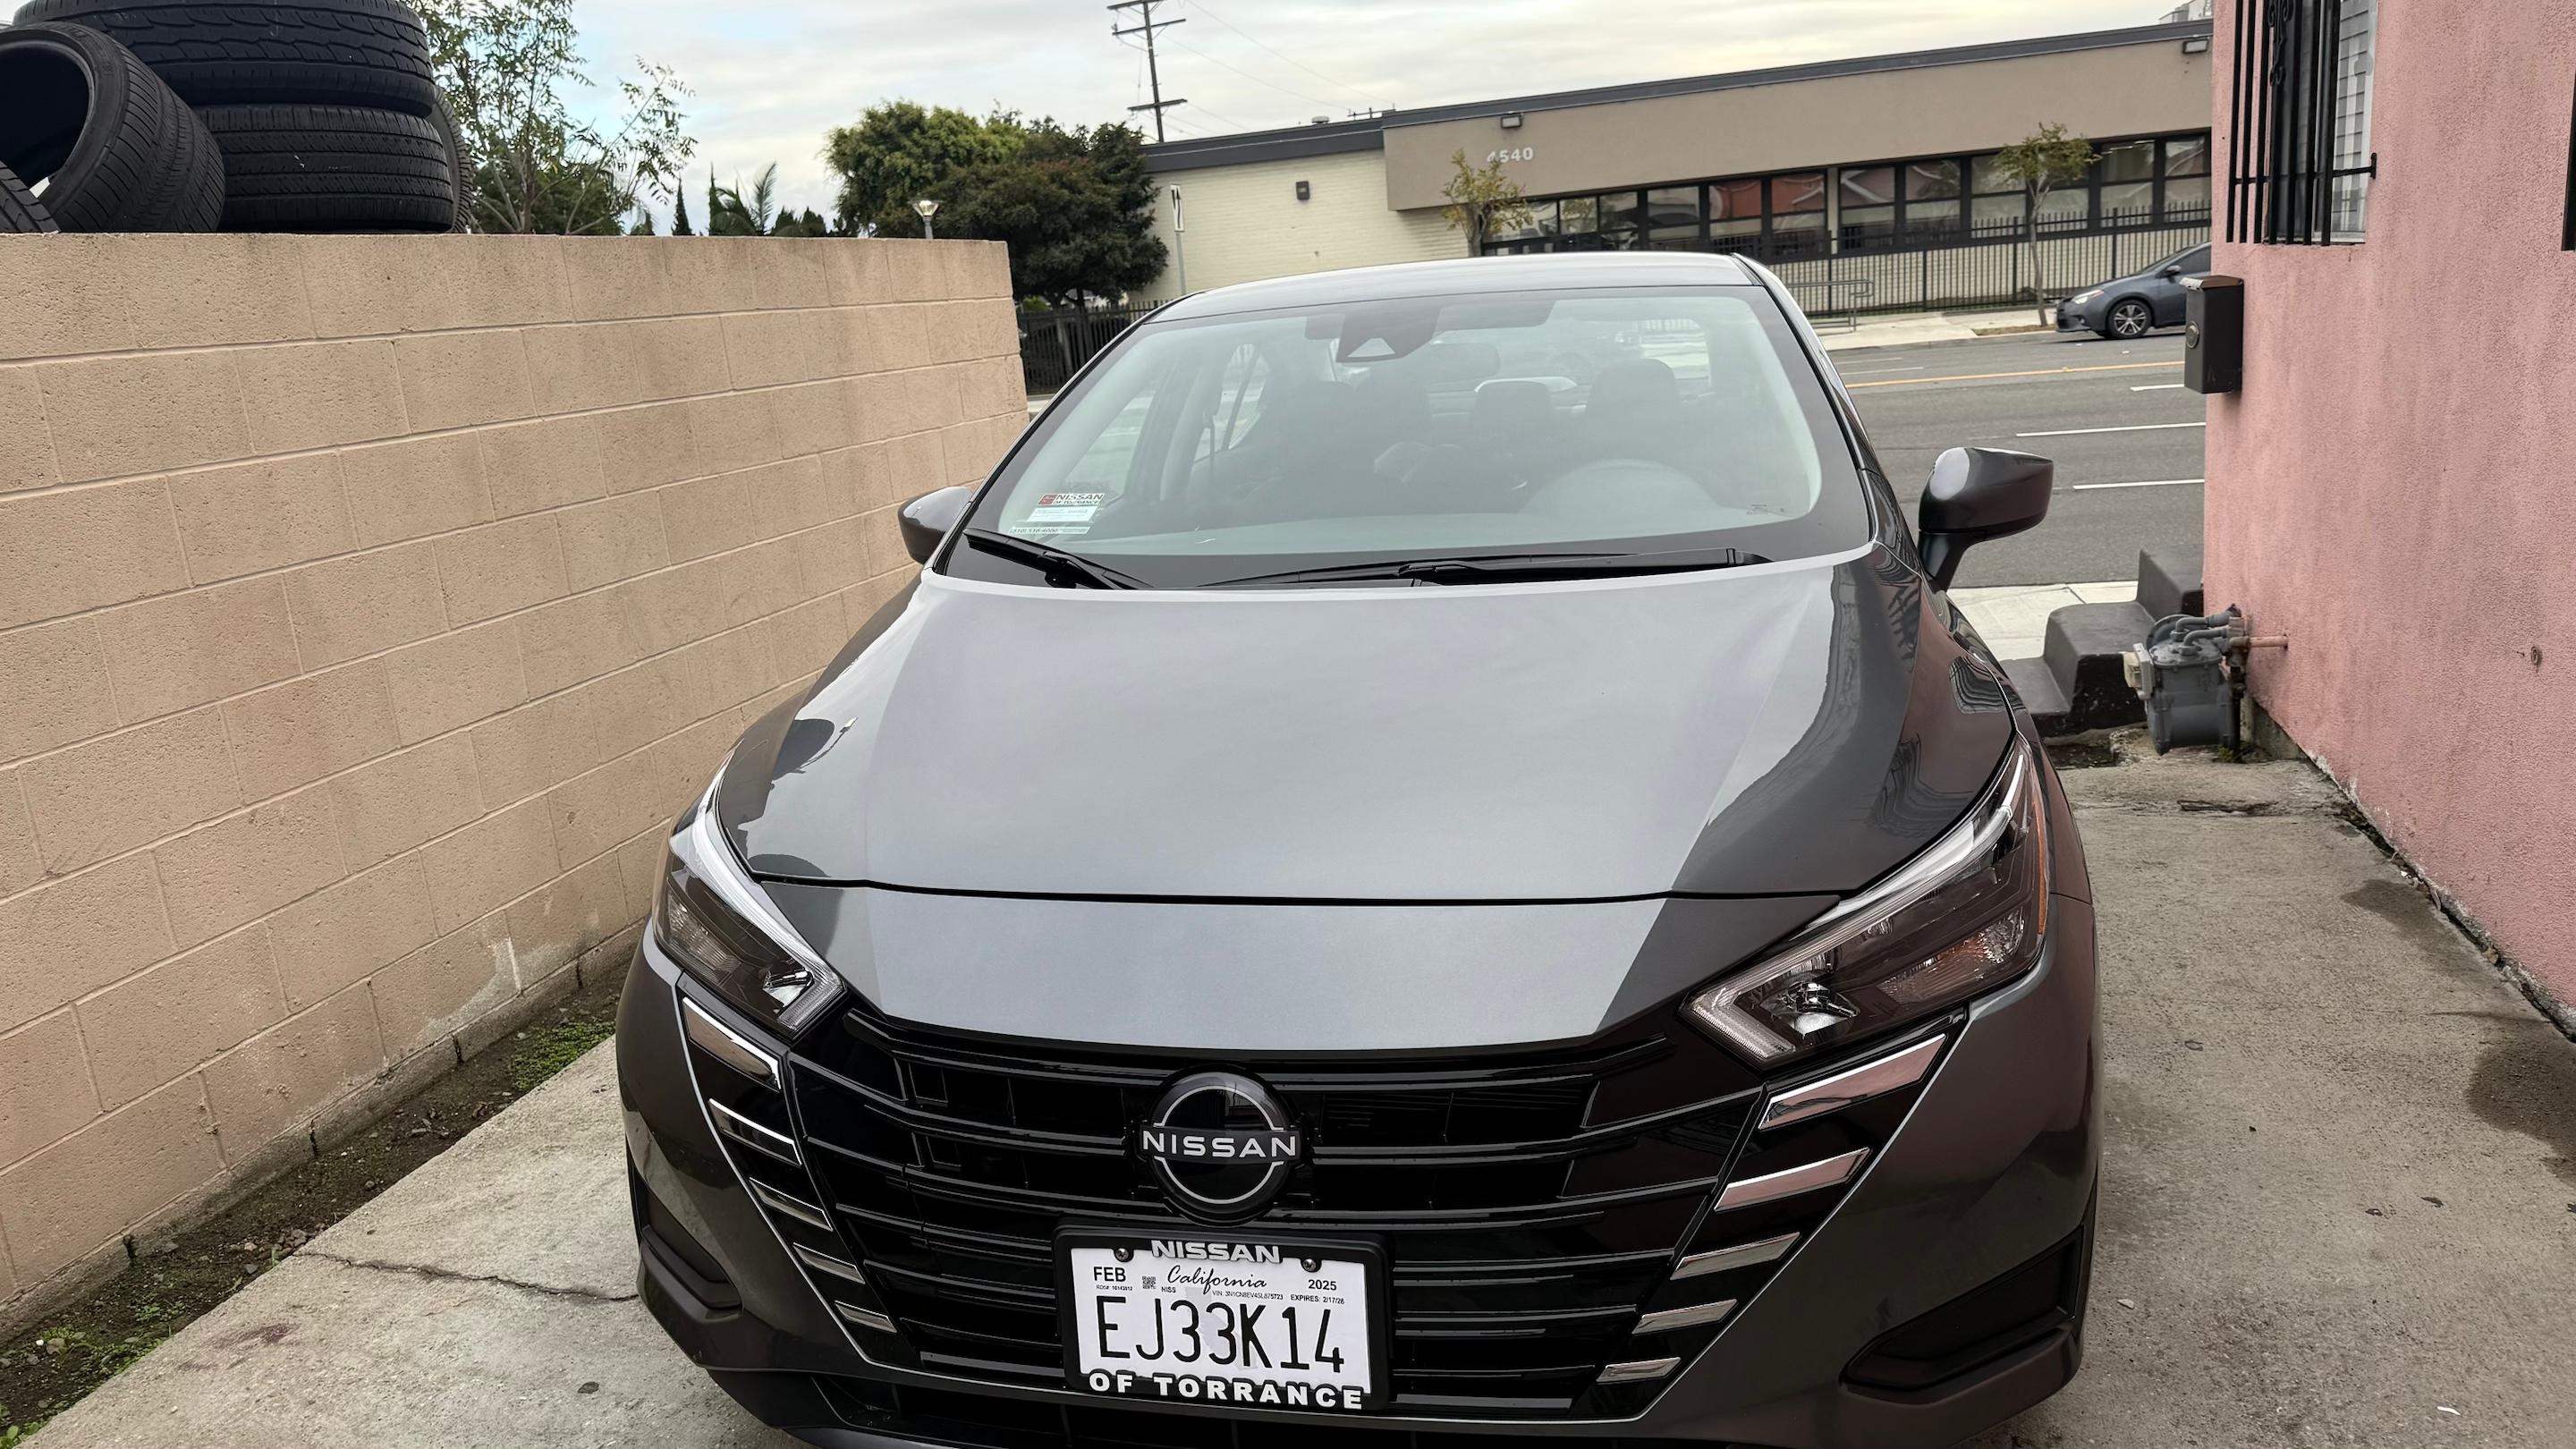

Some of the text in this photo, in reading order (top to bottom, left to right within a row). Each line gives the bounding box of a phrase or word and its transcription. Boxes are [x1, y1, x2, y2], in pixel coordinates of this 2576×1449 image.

[1487, 147, 1534, 163] 4540
[1142, 1130, 1296, 1158] NISSAN
[1151, 1240, 1280, 1264] NISSAN
[1093, 1267, 1126, 1283] FEB
[1167, 1265, 1267, 1295] California
[1308, 1279, 1337, 1291] 2025
[1097, 1295, 1345, 1372] EJ33K14
[1089, 1372, 1363, 1410] OF TORRANCE
